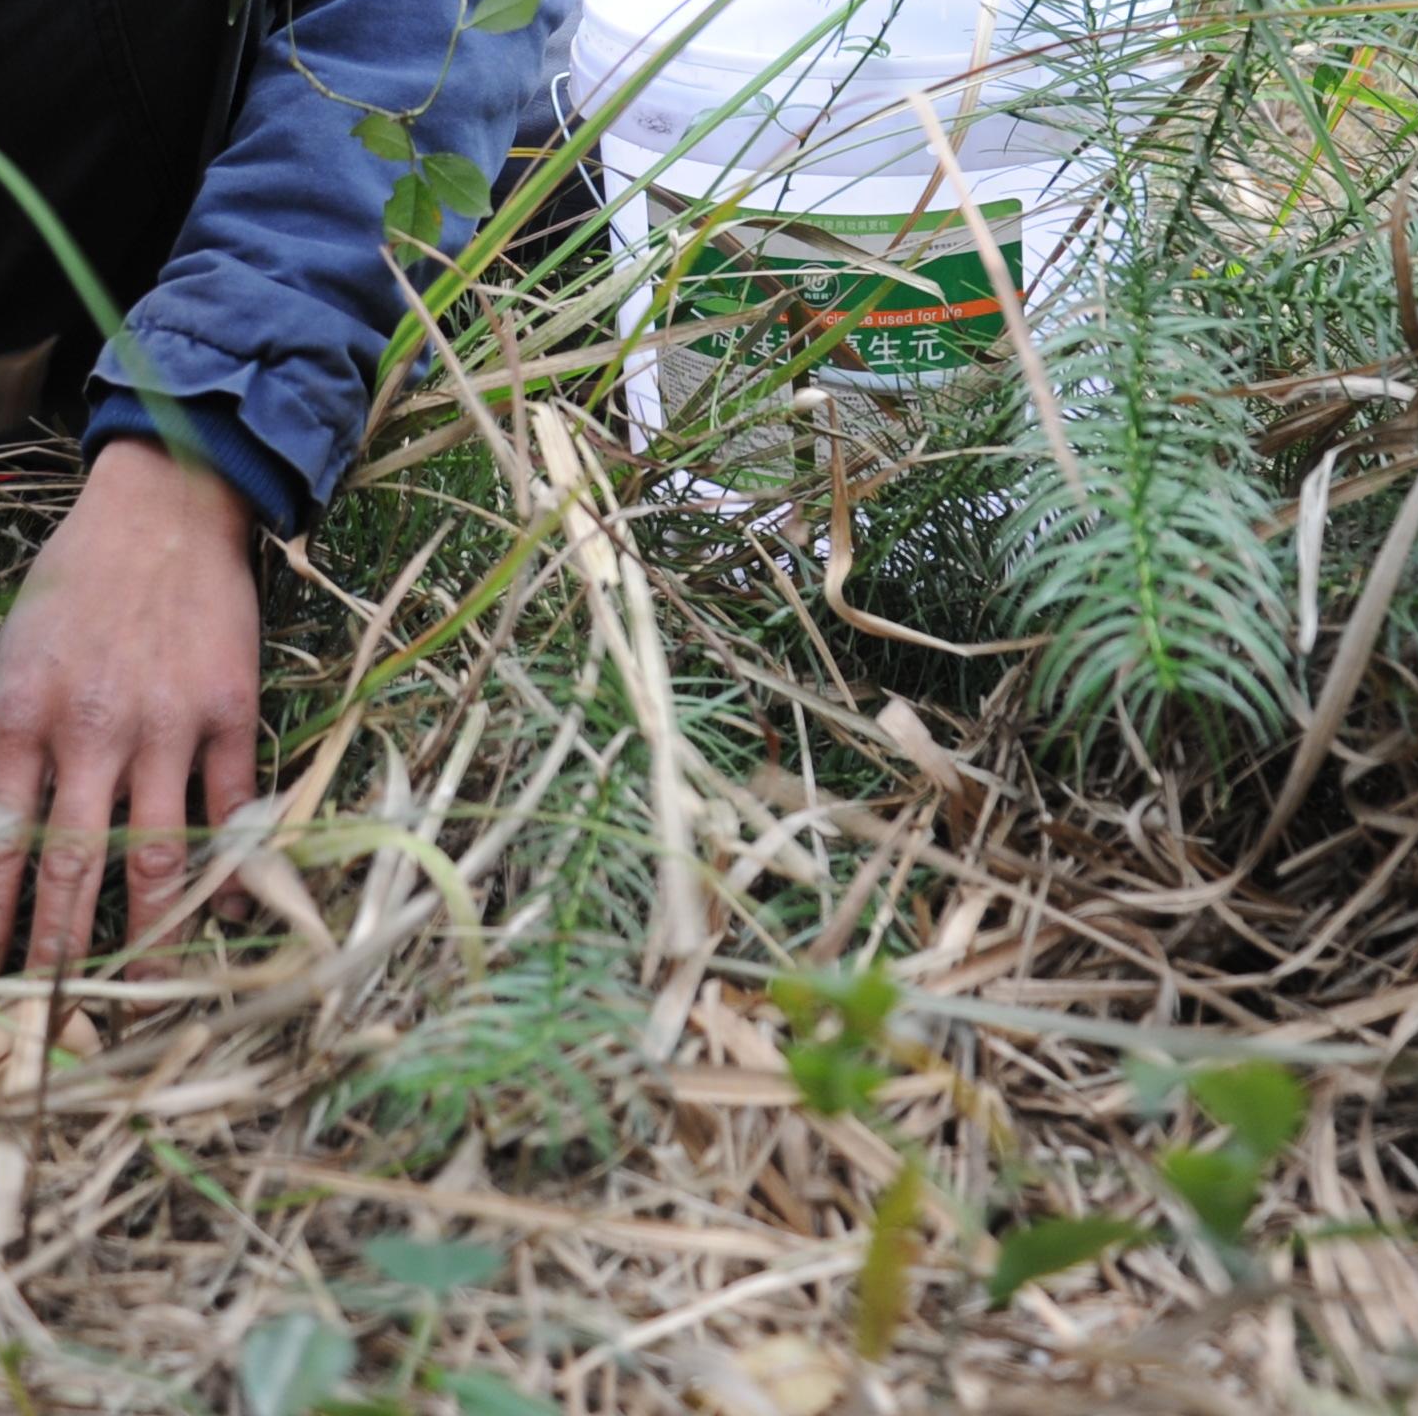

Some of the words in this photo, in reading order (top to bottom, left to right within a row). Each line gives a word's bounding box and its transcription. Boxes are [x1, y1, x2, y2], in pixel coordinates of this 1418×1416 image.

[878, 311, 913, 326] used
[918, 309, 937, 322] for
[942, 306, 963, 320] life
